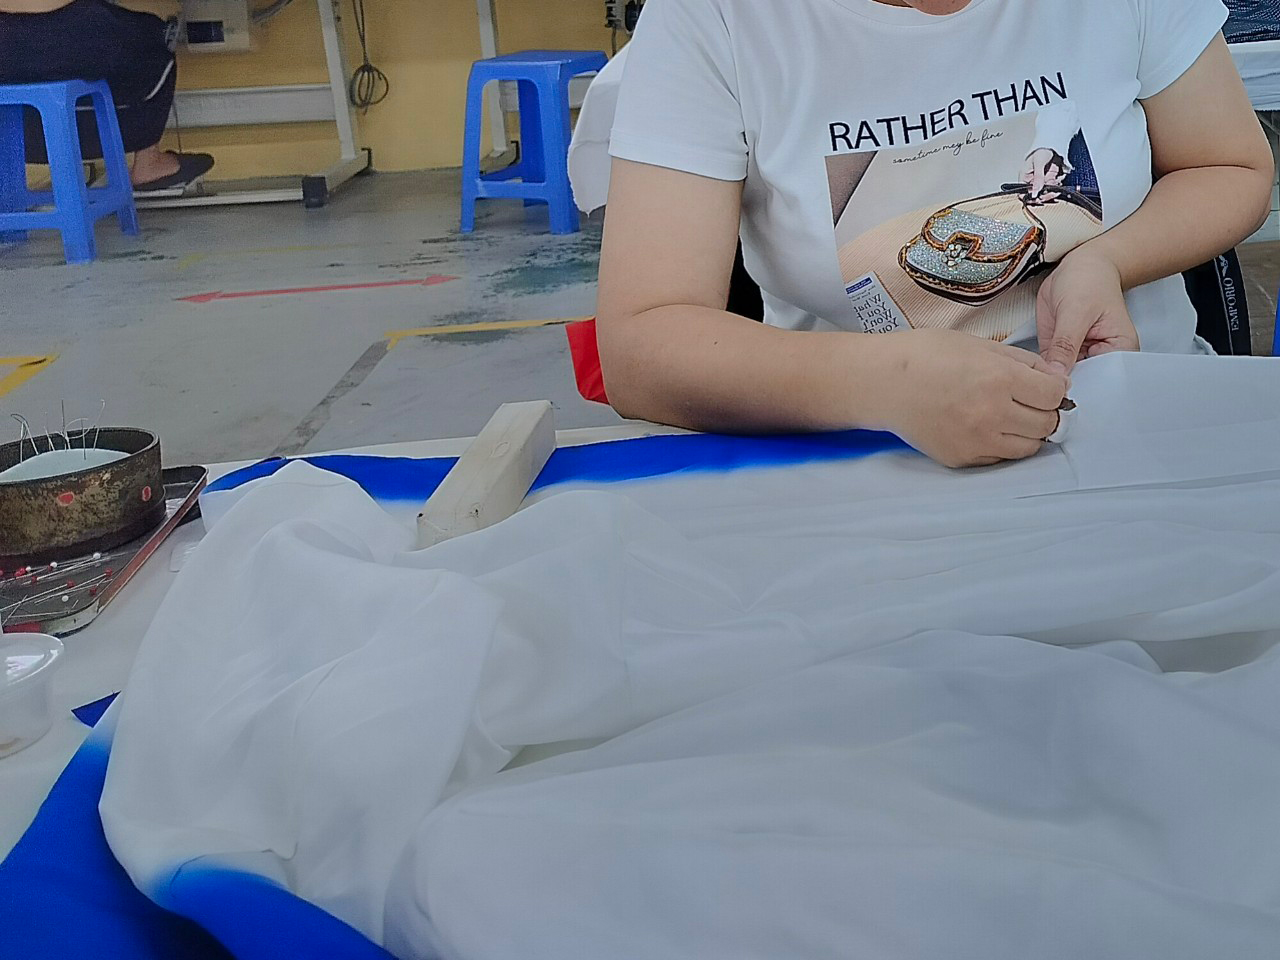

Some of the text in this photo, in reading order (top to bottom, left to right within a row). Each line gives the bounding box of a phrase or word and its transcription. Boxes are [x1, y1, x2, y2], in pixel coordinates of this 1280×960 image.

[828, 71, 1068, 152] RATHER THAN
[965, 131, 980, 145] be
[980, 128, 1004, 148] fine
[1222, 277, 1239, 332] EMPORIO
